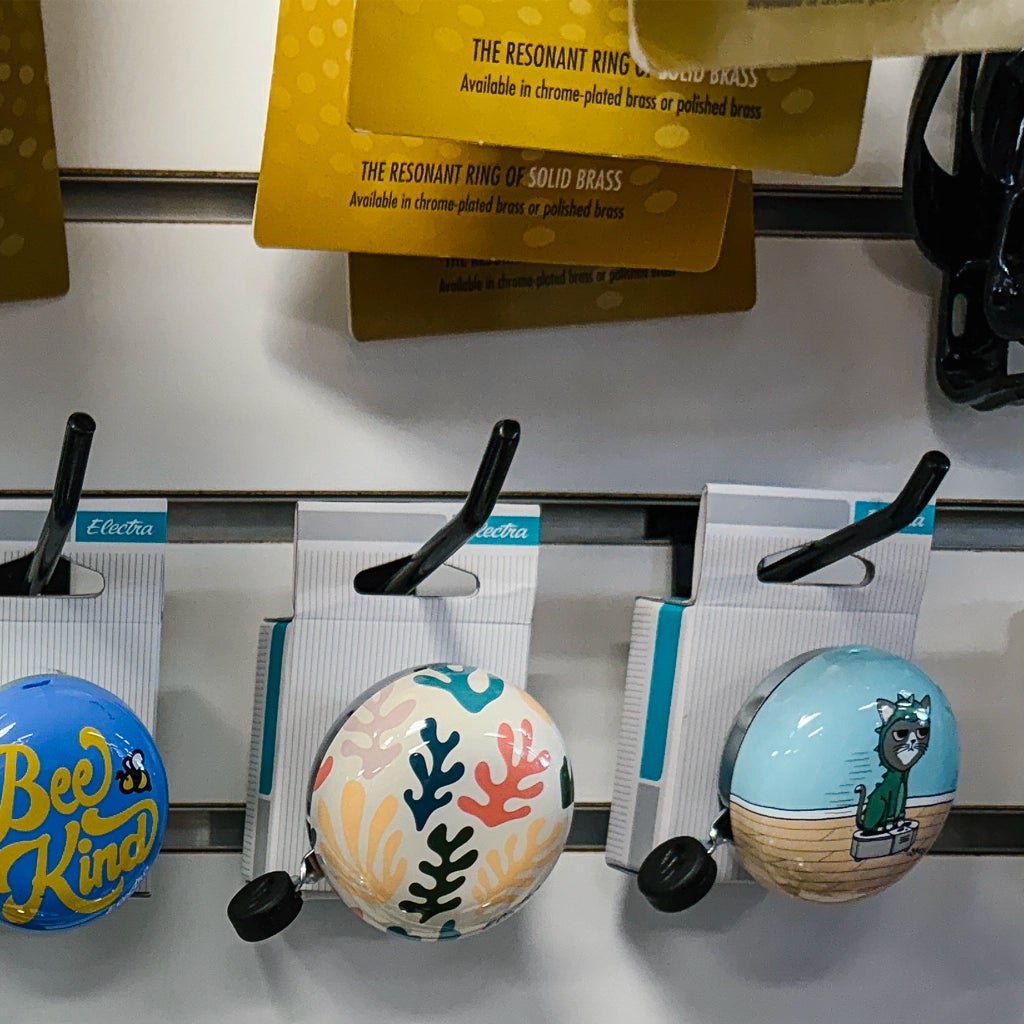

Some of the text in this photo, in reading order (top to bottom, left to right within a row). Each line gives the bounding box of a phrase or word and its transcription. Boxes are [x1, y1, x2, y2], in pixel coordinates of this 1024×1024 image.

[473, 38, 500, 64] THE
[506, 41, 588, 72] RESONANT
[592, 49, 630, 76] RING
[460, 73, 763, 120] Available in chrome-plated brass or polished brass
[361, 160, 623, 192] THE RESONANT RING OF SOLID BRASS
[349, 191, 625, 220] Available in chrome-plated brass or polished brass
[86, 518, 154, 536] Electra
[476, 522, 529, 539] lectra
